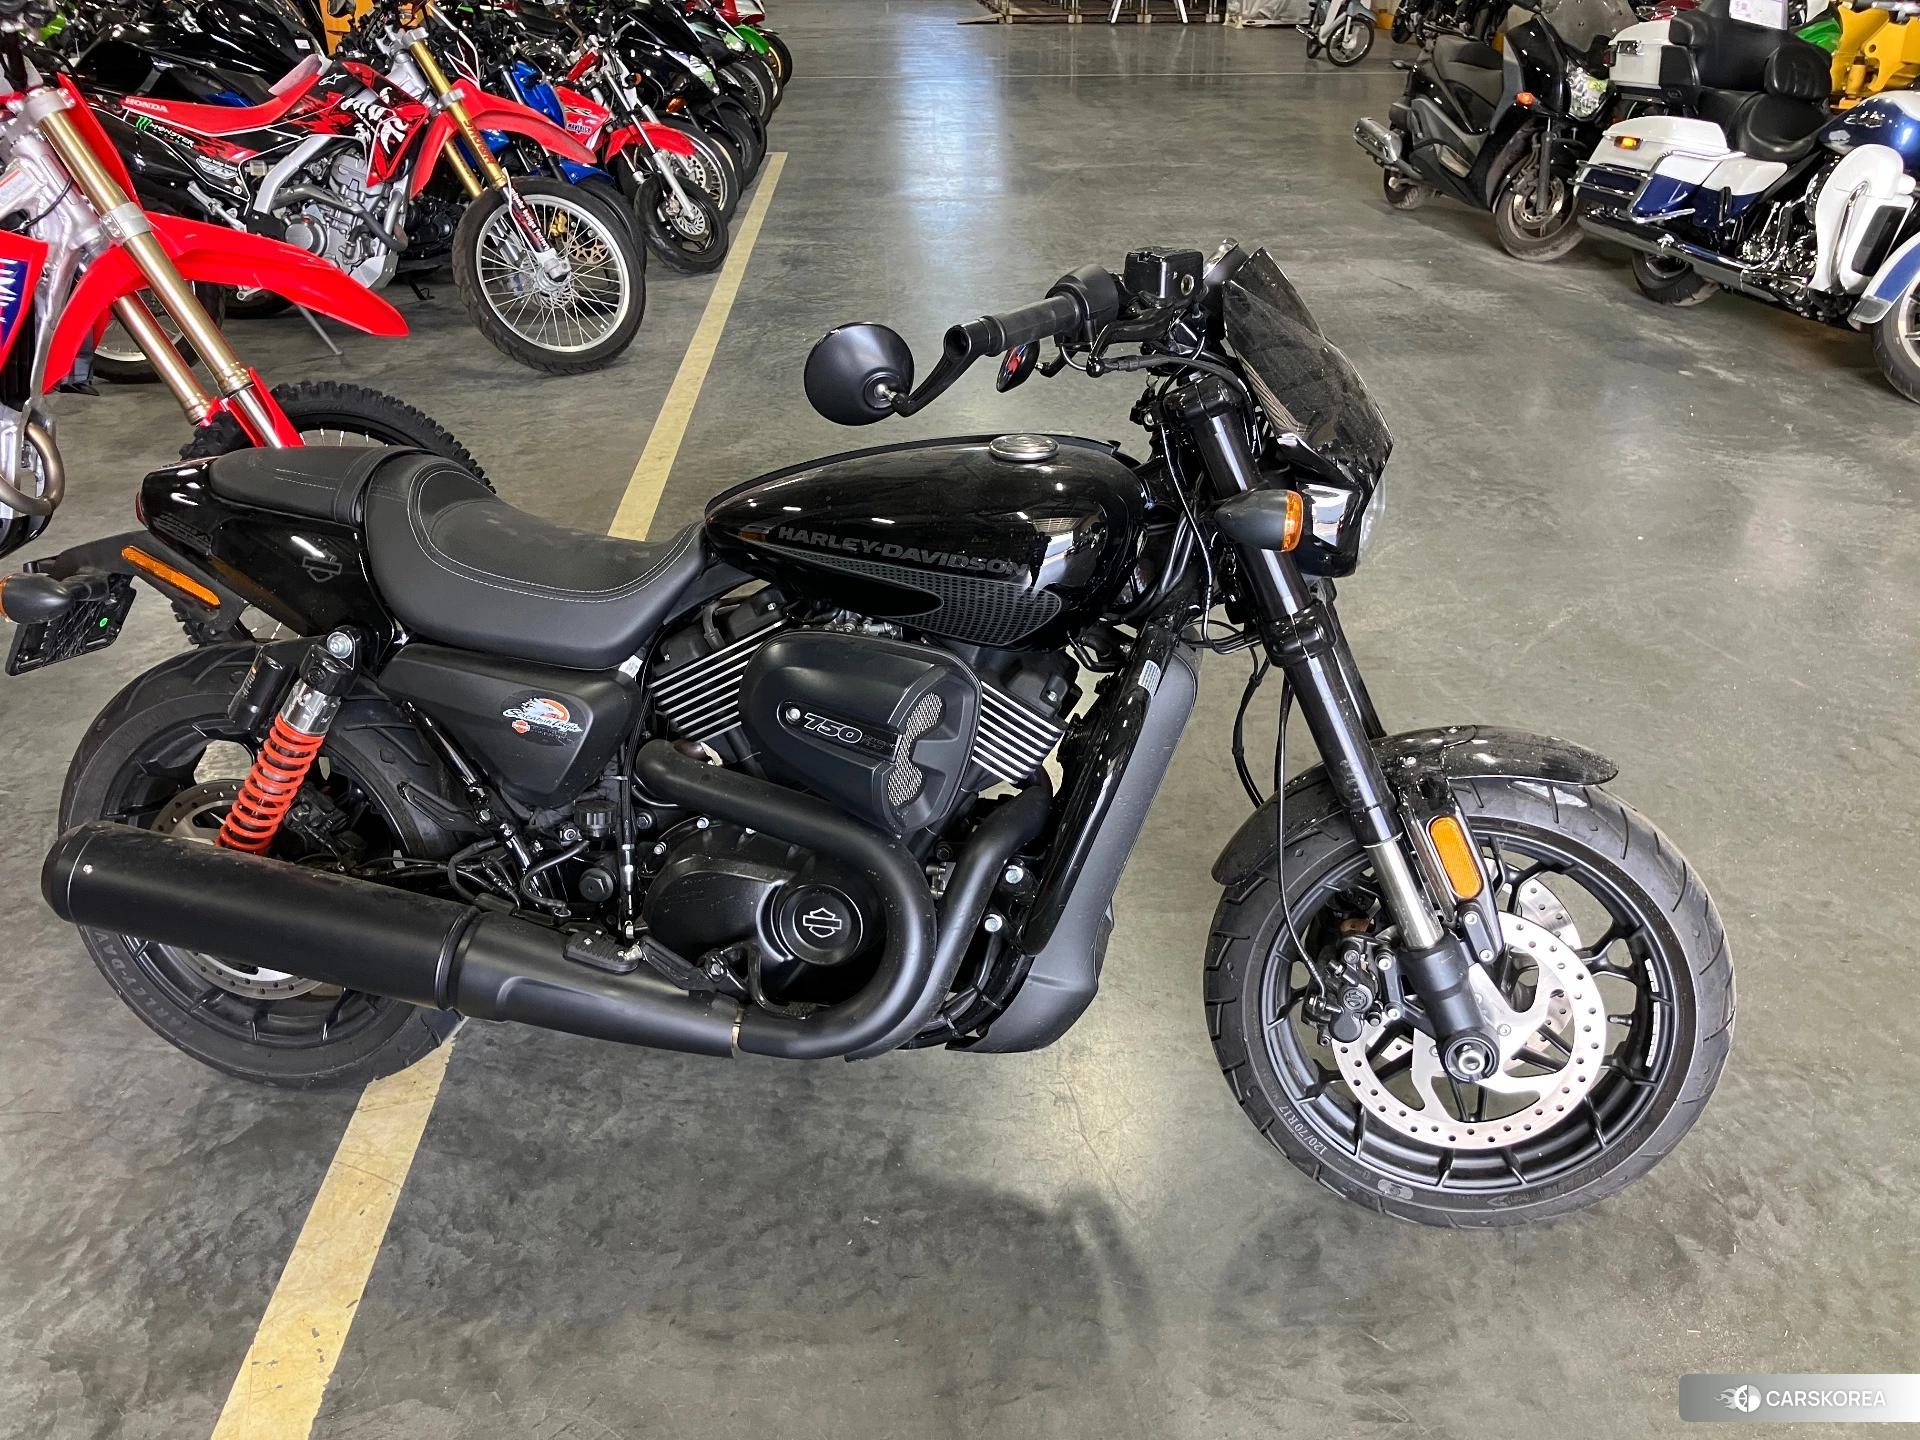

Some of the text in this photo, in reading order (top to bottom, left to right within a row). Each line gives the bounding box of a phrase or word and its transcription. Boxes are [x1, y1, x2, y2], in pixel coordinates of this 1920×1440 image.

[124, 97, 169, 114] HONDA
[149, 122, 195, 148] MONSTER
[778, 526, 1029, 576] HARLEY-DAVIDSON
[803, 712, 863, 744] 750
